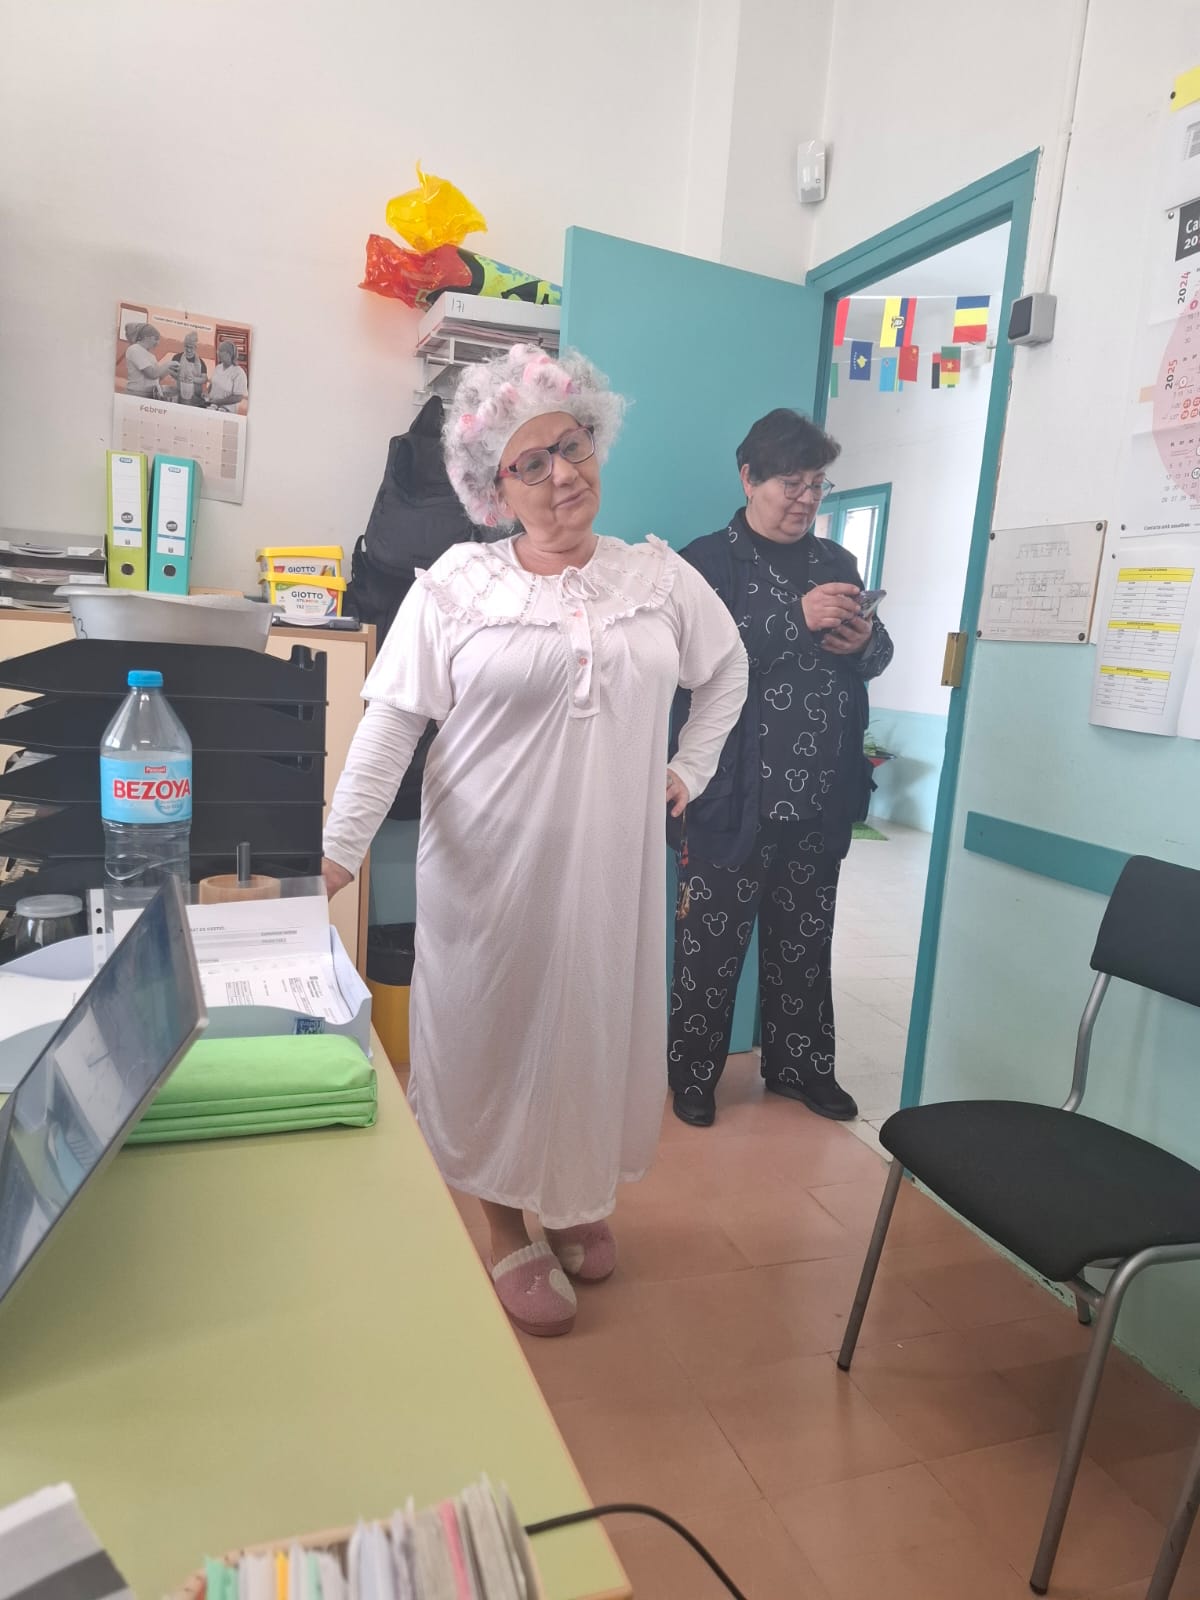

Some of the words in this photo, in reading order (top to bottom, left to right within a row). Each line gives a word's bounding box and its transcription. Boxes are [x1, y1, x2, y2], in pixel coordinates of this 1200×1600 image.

[1185, 219, 1200, 234] Ca
[1183, 235, 1200, 250] 20
[1177, 271, 1191, 304] 2024
[1164, 359, 1178, 391] 2025
[139, 404, 168, 415] Febrer
[291, 591, 323, 599] GIOTTO
[114, 778, 191, 800] BEZOYA
